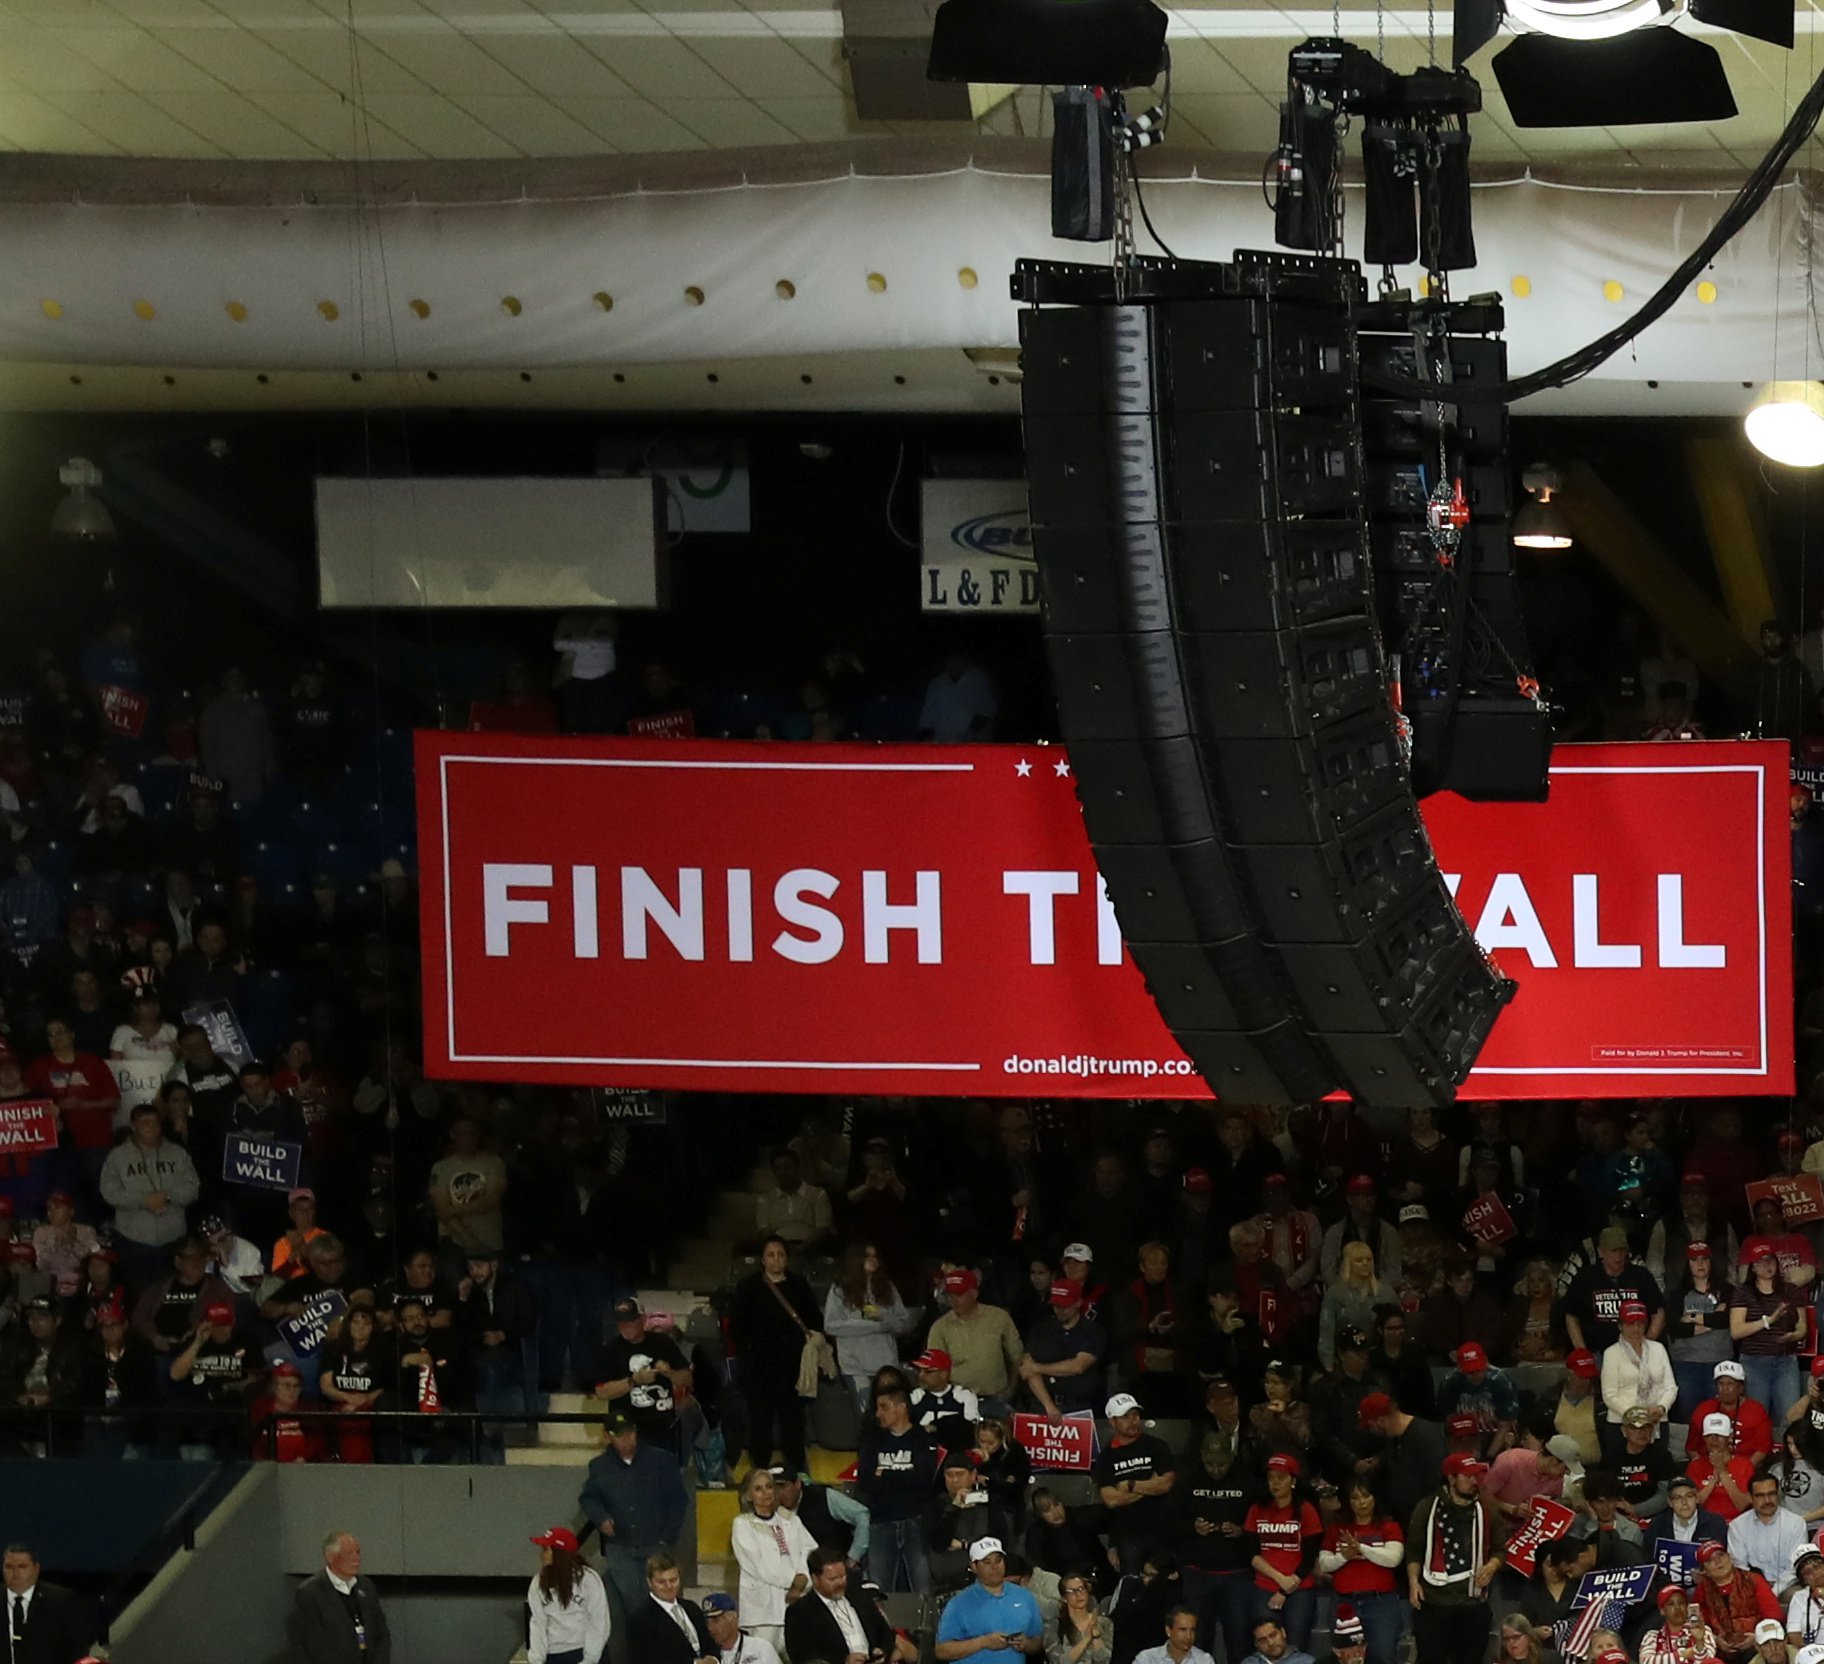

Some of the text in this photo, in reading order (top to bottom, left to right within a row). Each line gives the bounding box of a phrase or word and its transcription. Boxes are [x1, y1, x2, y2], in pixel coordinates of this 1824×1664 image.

[483, 862, 944, 967] FINISH
[1451, 873, 1727, 969] ALL
[1003, 1054, 1197, 1079] donaldjtrump.co
[606, 1103, 655, 1119] WALL
[238, 1141, 287, 1160] BUILD
[236, 1162, 286, 1183] WALL
[336, 1375, 371, 1391] TRUMP
[1026, 1422, 1080, 1440] WALL
[1025, 1446, 1080, 1463] FINISH
[1114, 1456, 1152, 1471] TRUMP
[1508, 1506, 1548, 1556] FINISH
[1593, 1570, 1642, 1586] BUILD
